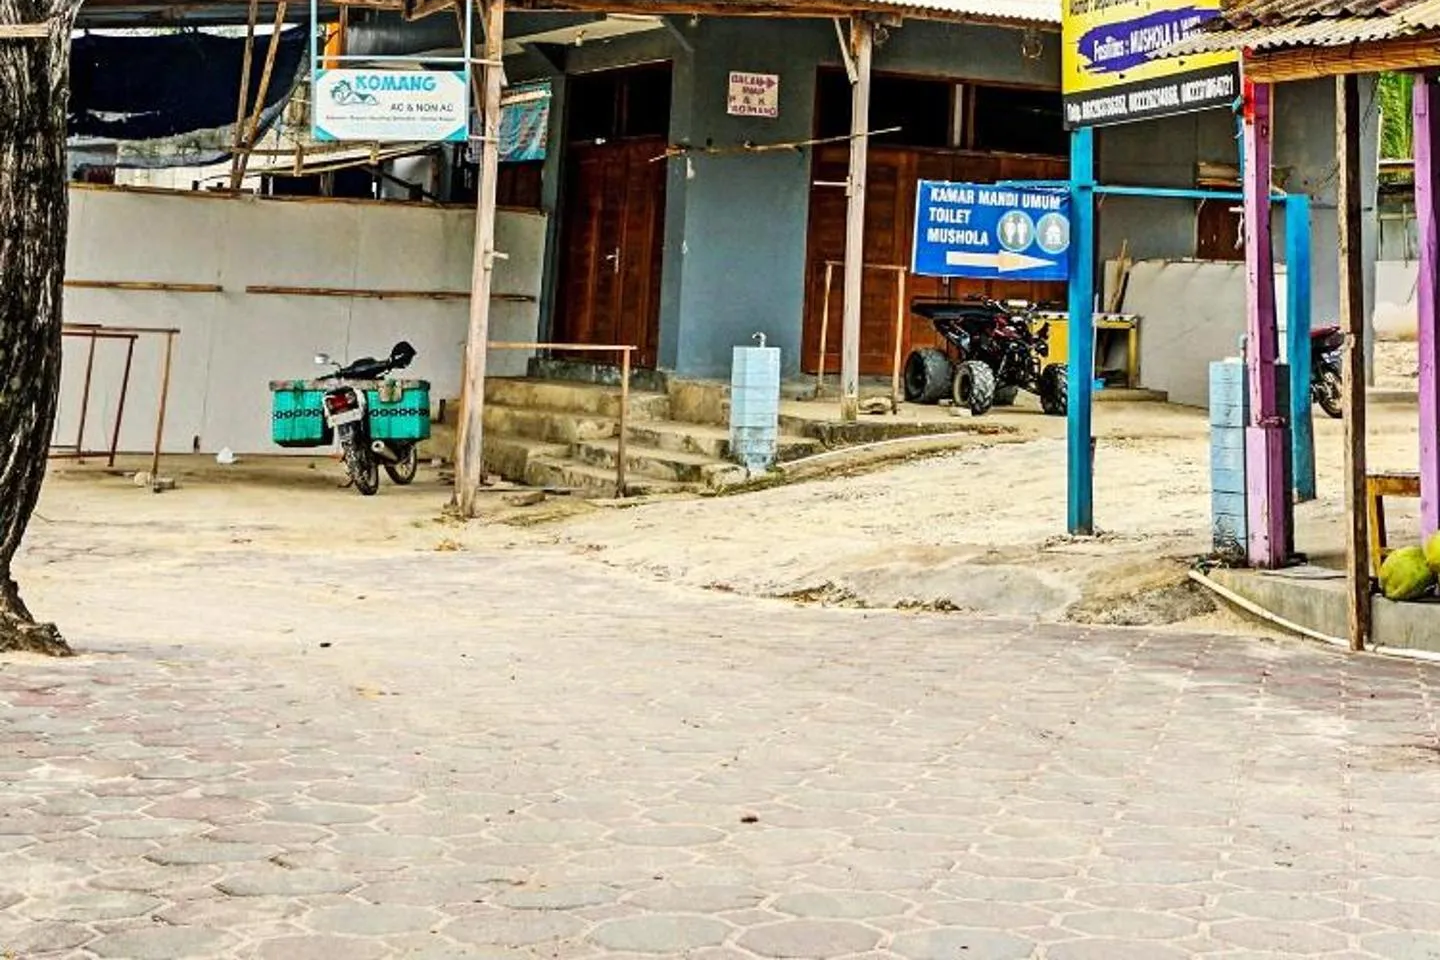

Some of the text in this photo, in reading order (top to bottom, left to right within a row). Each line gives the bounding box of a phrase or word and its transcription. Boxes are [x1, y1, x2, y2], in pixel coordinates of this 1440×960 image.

[355, 75, 437, 92] KOMANG
[390, 104, 404, 113] AC
[416, 104, 438, 113] NON
[440, 104, 454, 113] AC
[930, 187, 1061, 210] KAMAR MANDI UMUM
[929, 207, 972, 224] TOILET
[927, 228, 989, 246] MUSHOLA
